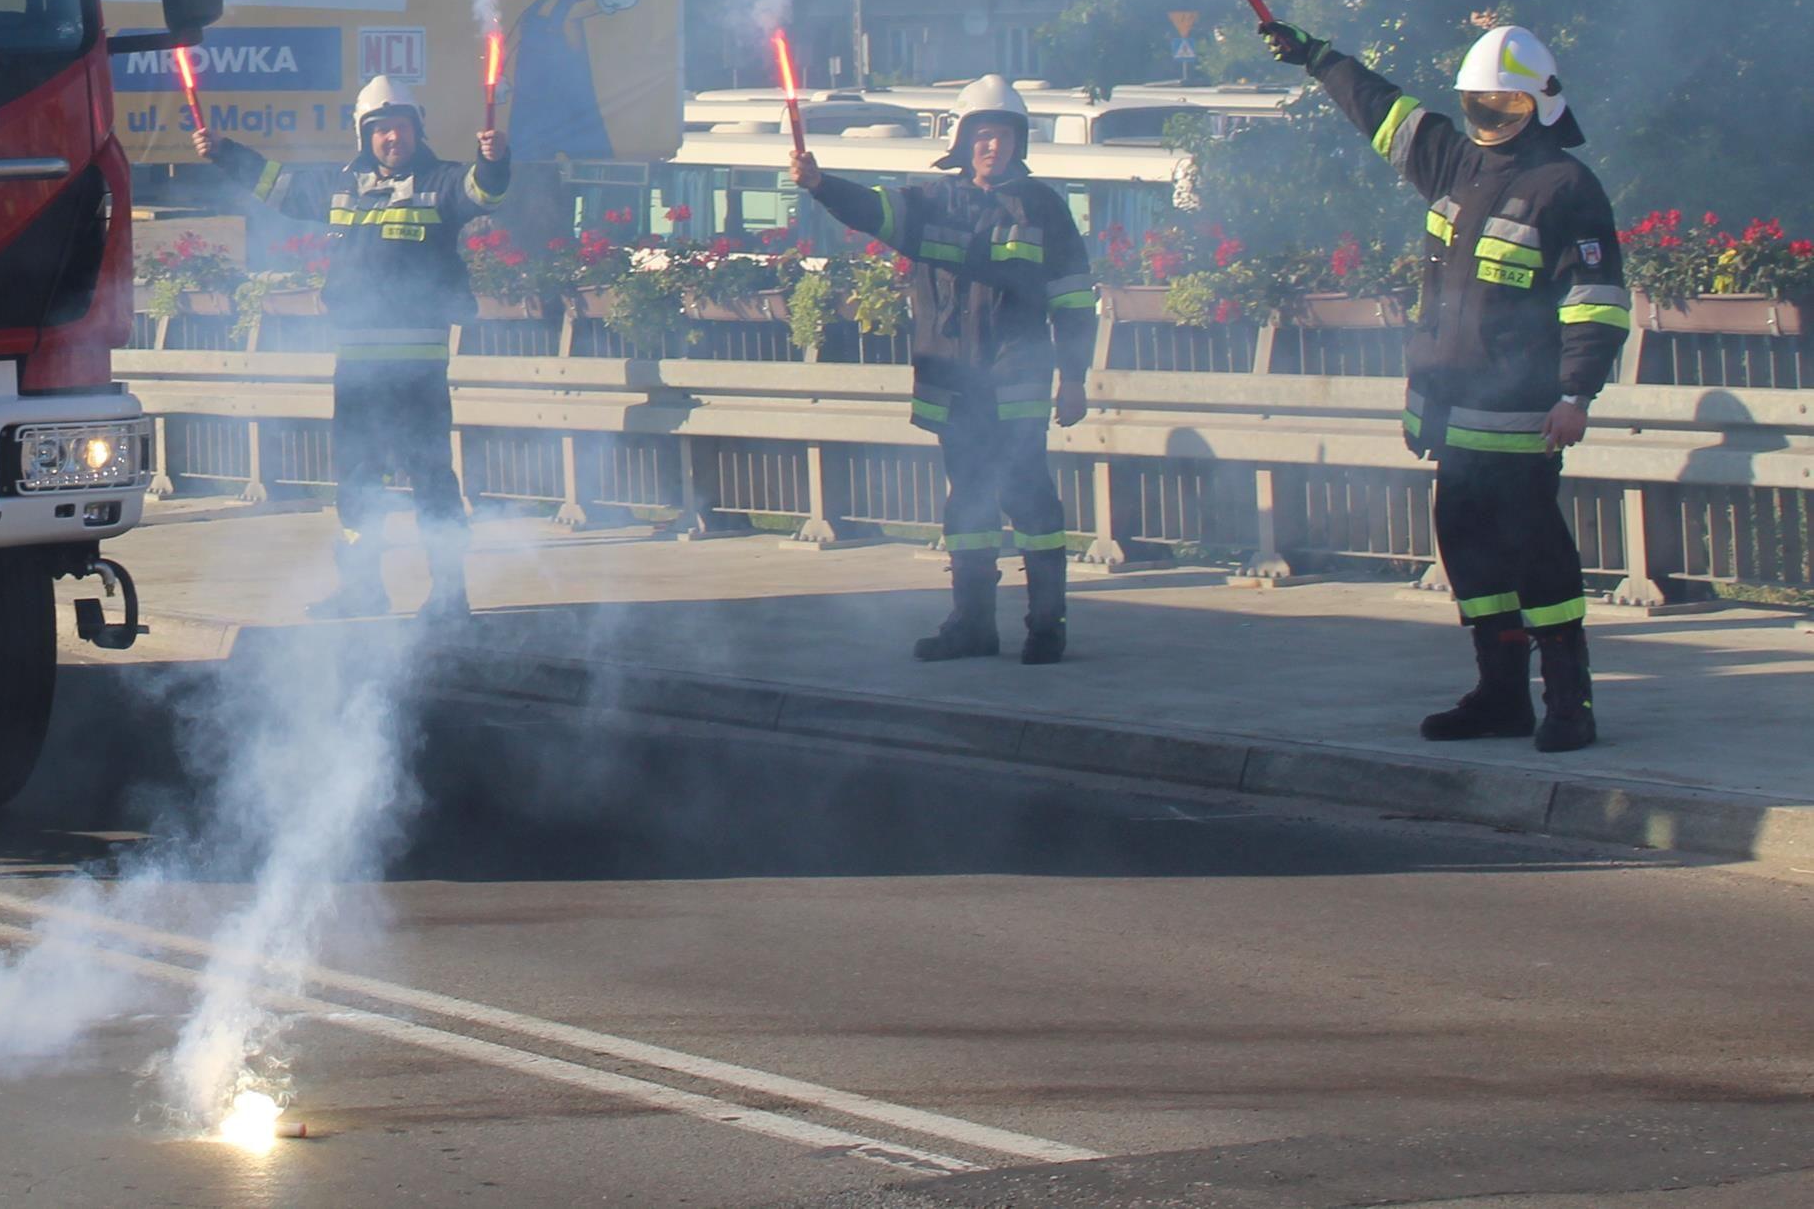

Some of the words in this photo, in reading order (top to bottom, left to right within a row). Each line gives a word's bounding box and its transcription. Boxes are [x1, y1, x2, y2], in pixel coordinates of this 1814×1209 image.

[364, 33, 420, 76] NCL
[127, 104, 167, 132] ul.
[178, 104, 197, 132] 3
[210, 103, 298, 137] Maja
